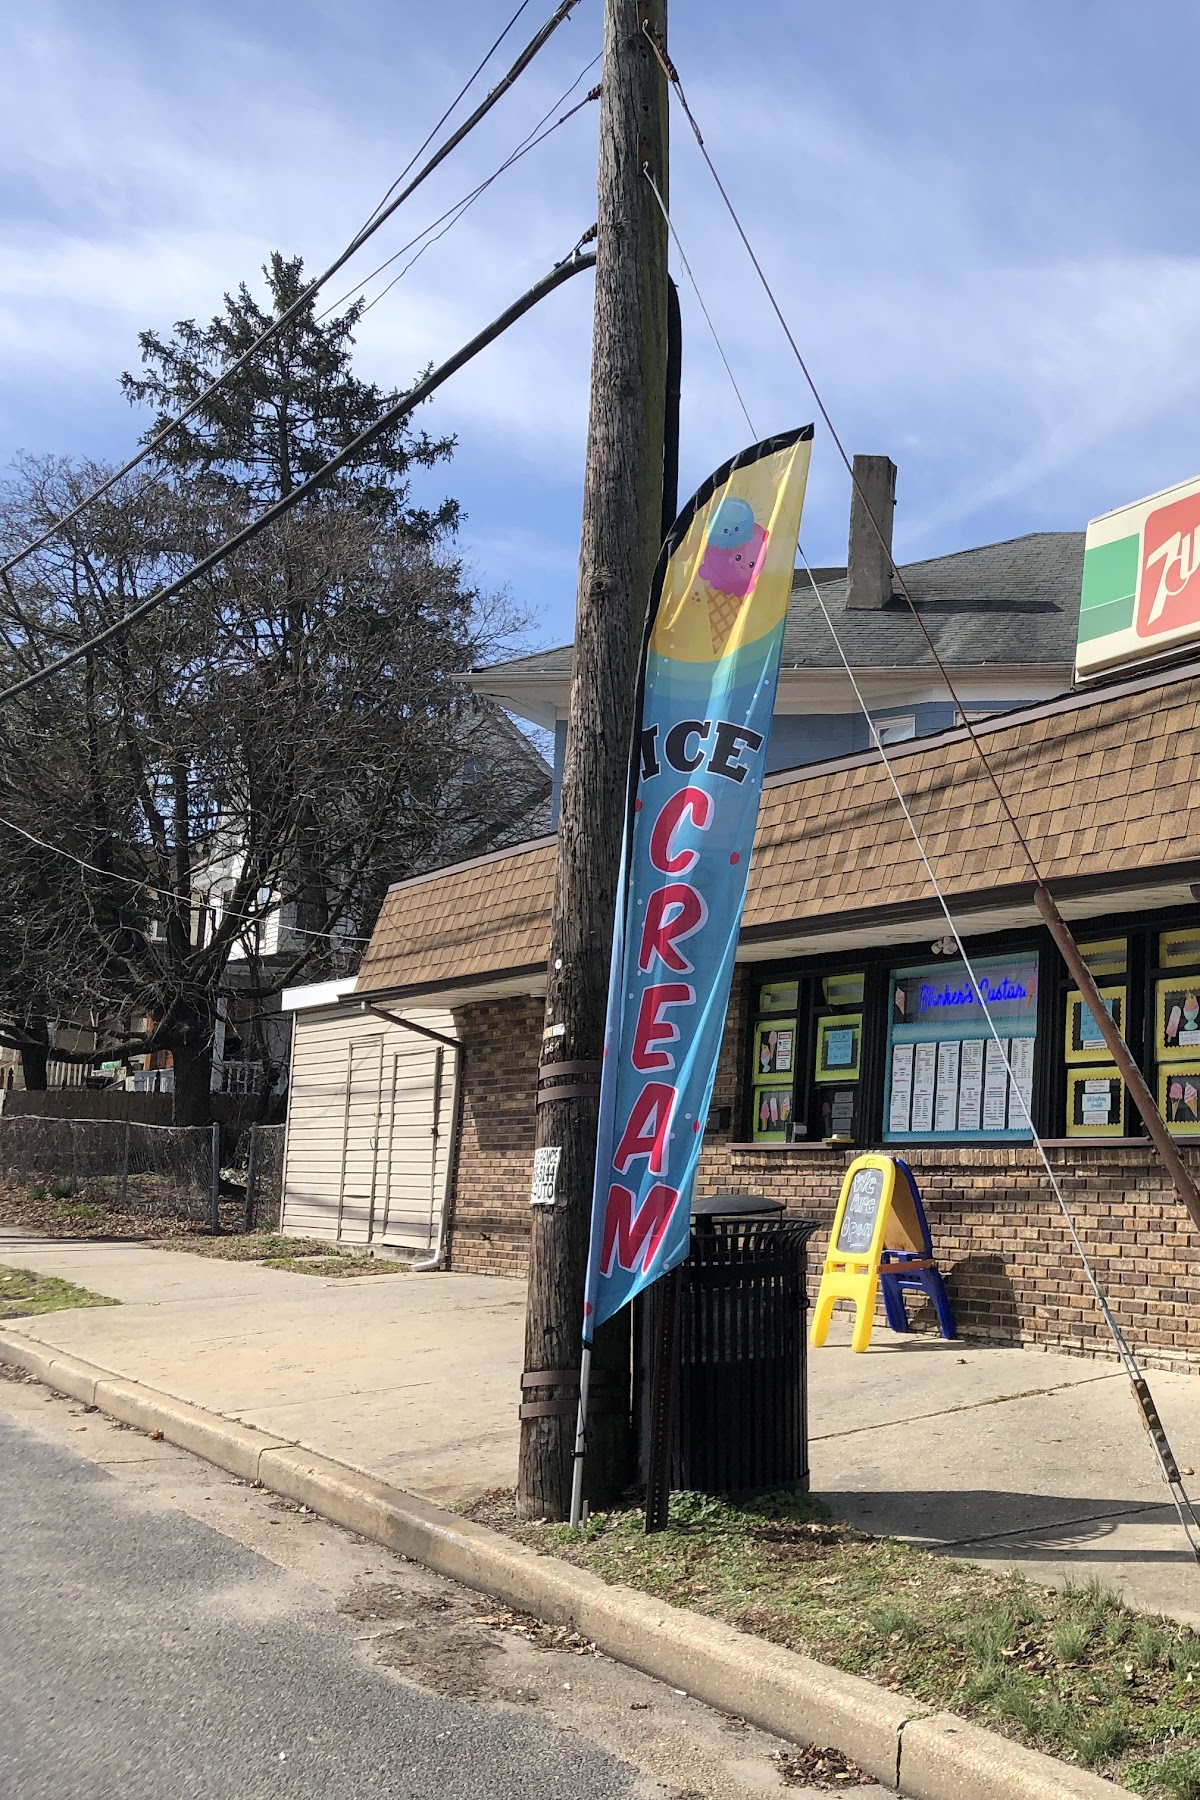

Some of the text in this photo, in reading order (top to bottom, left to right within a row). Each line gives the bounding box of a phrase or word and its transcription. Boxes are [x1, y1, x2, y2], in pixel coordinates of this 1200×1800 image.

[640, 718, 766, 786] ICE
[919, 976, 1028, 1014] Blinker's Custar
[599, 785, 716, 1279] CREAM
[840, 1216, 873, 1243] Open
